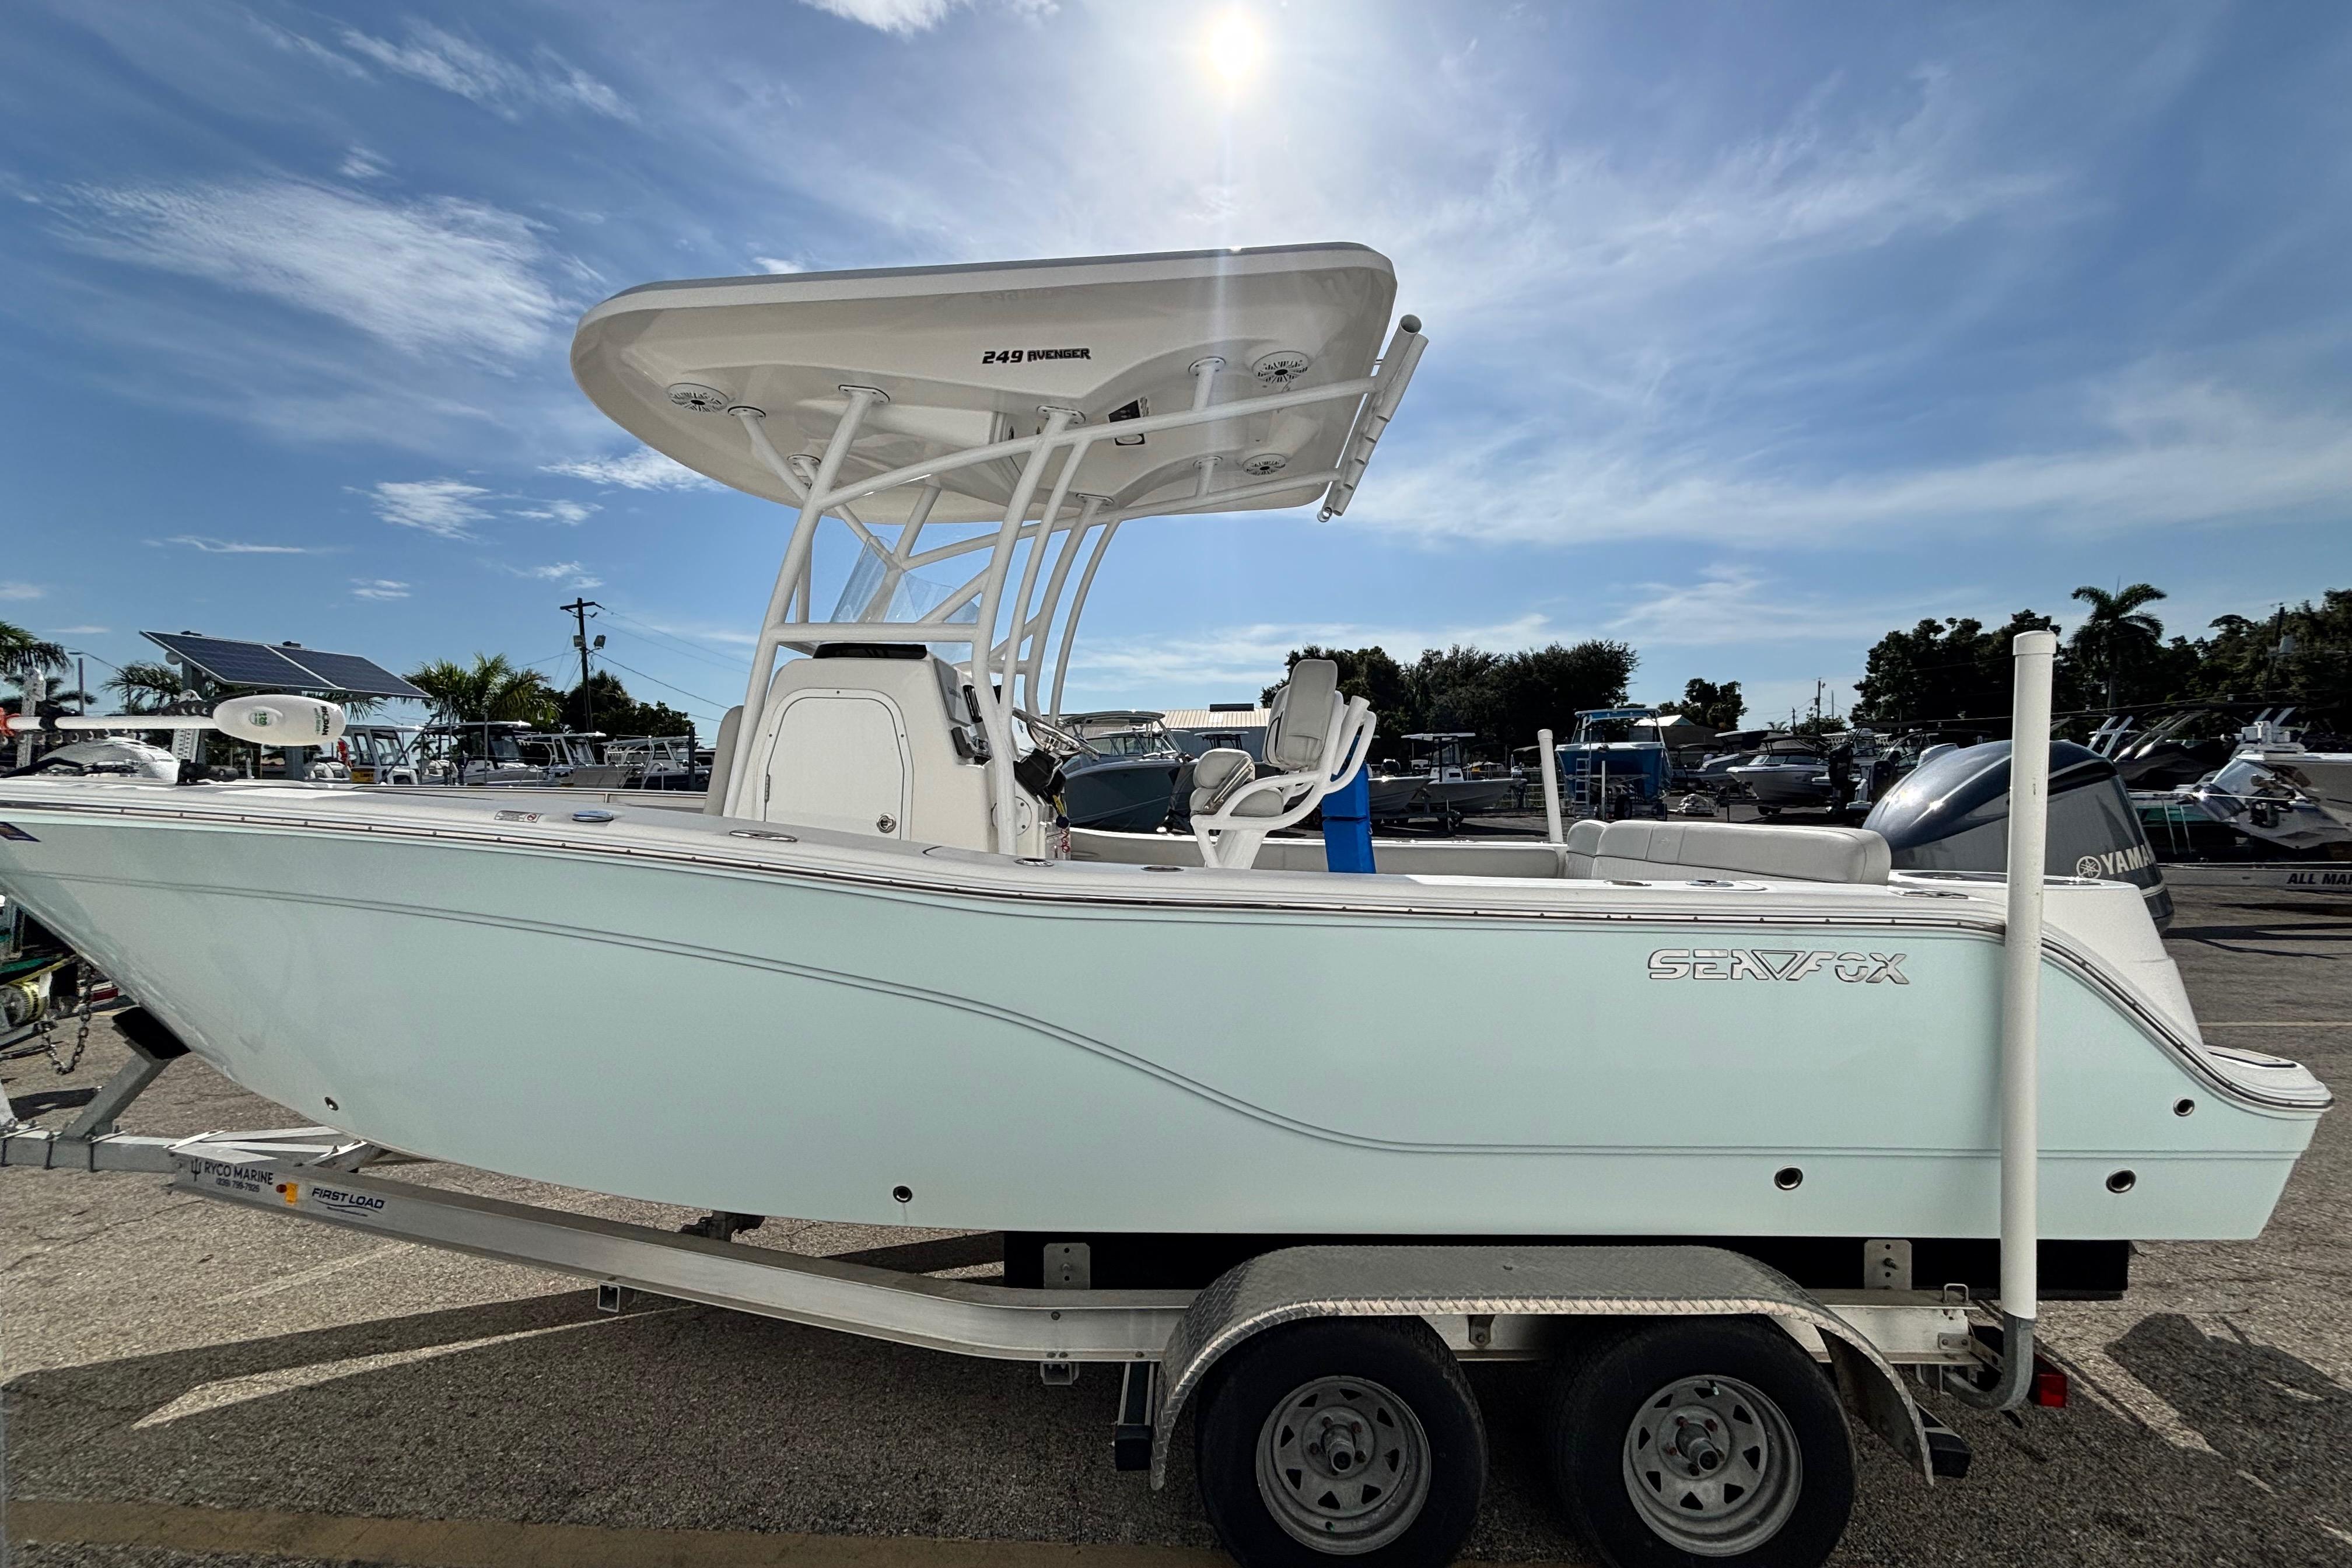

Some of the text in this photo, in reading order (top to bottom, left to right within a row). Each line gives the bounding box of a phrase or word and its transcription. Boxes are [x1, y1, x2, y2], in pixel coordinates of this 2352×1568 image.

[982, 348, 1091, 364] 249 AVENGER
[2287, 873, 2316, 884] ALL
[204, 1161, 274, 1185] RYCO MARINE
[312, 1188, 386, 1209] FIRST LOAD
